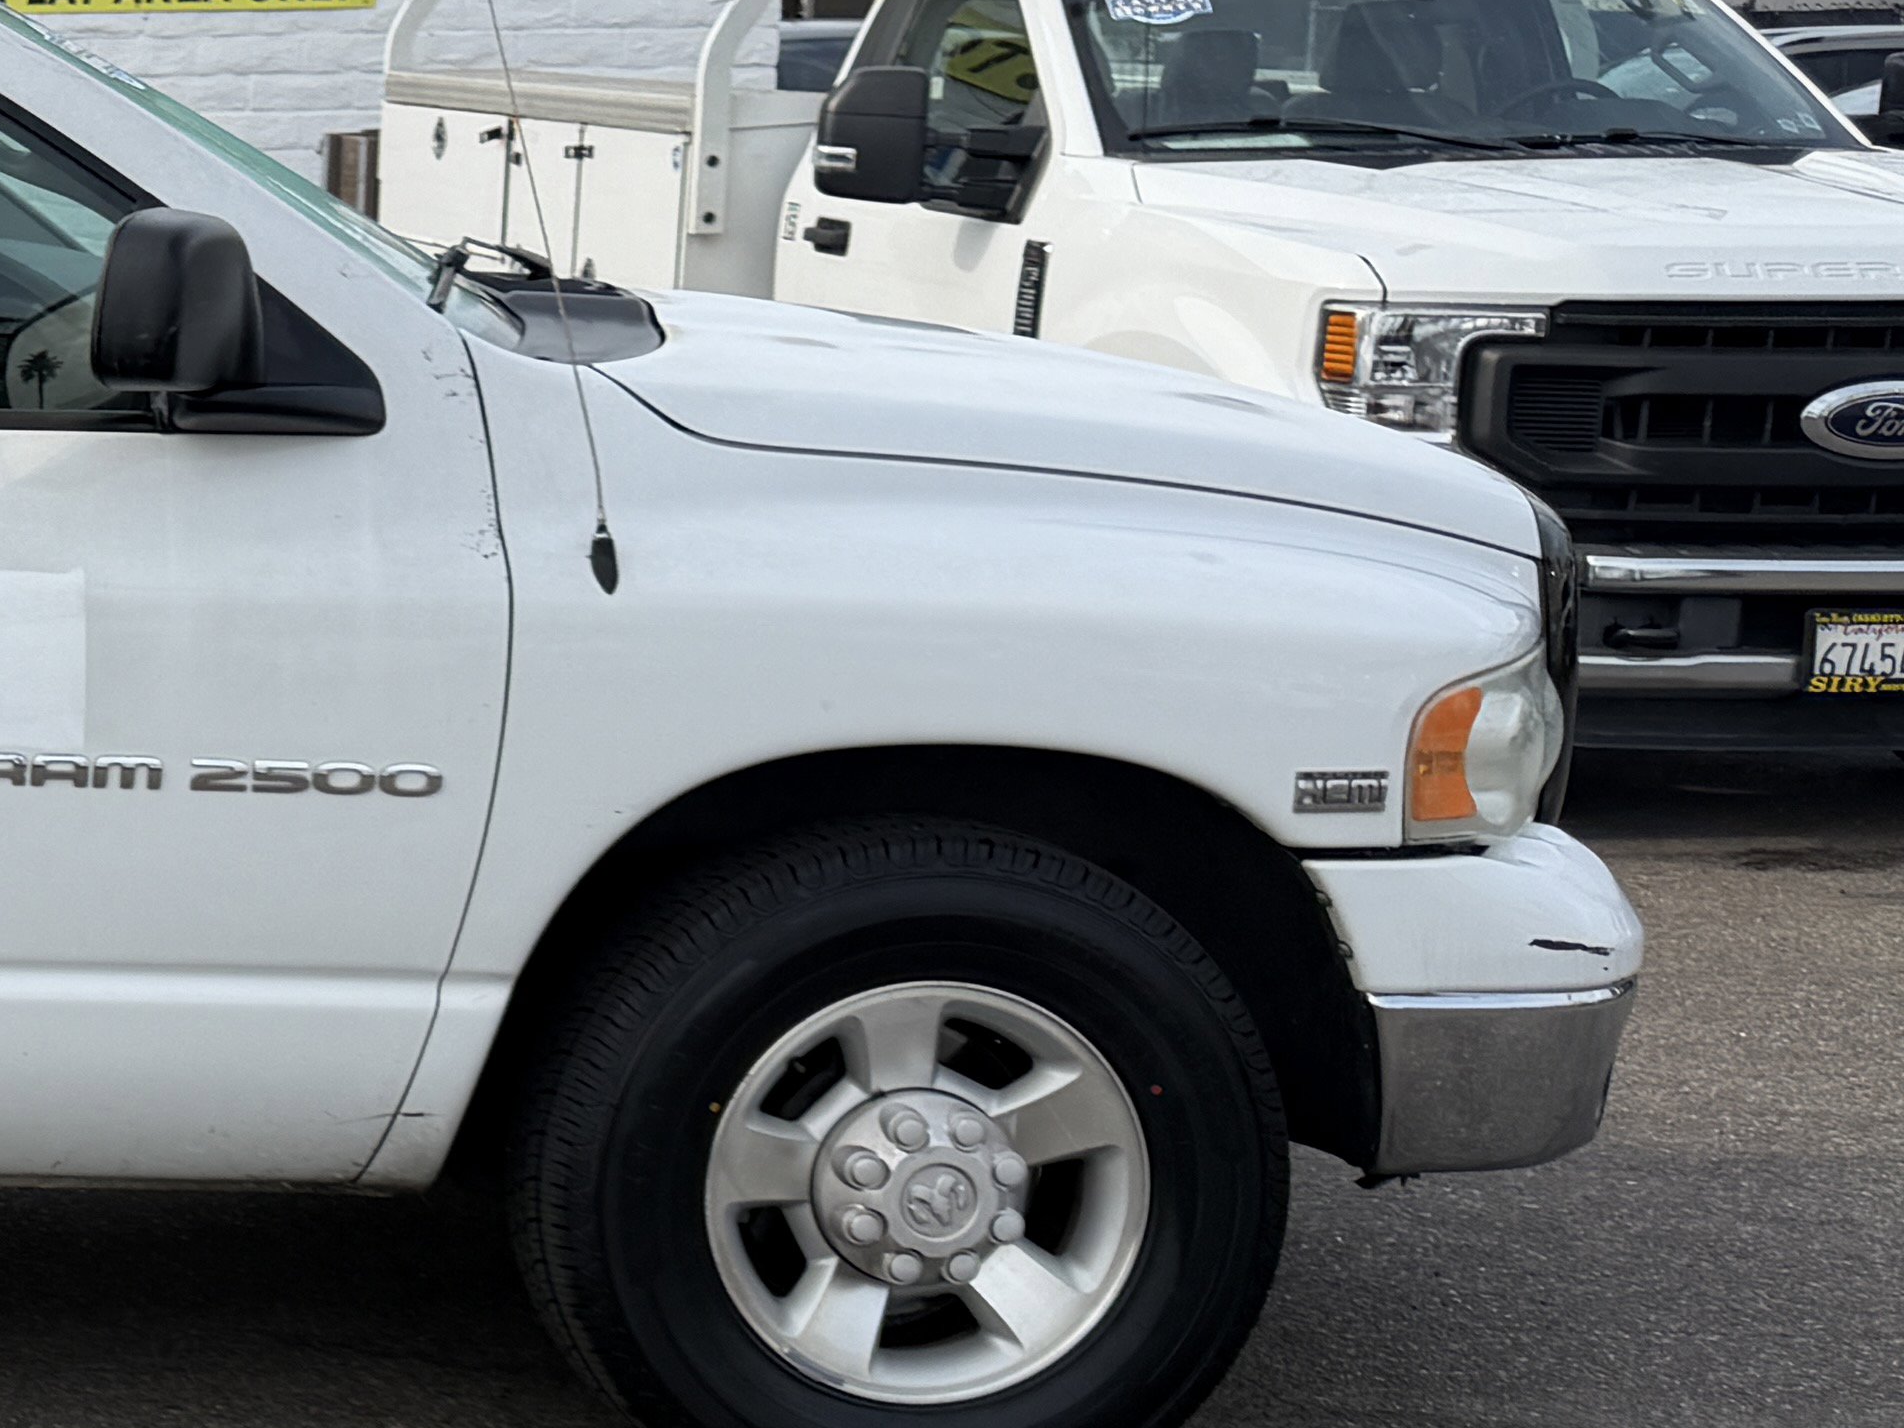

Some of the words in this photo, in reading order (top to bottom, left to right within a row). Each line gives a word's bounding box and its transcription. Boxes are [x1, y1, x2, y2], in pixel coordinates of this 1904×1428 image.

[1818, 642, 1904, 677] 6745
[1808, 675, 1886, 693] SIRY
[189, 758, 444, 798] 2500
